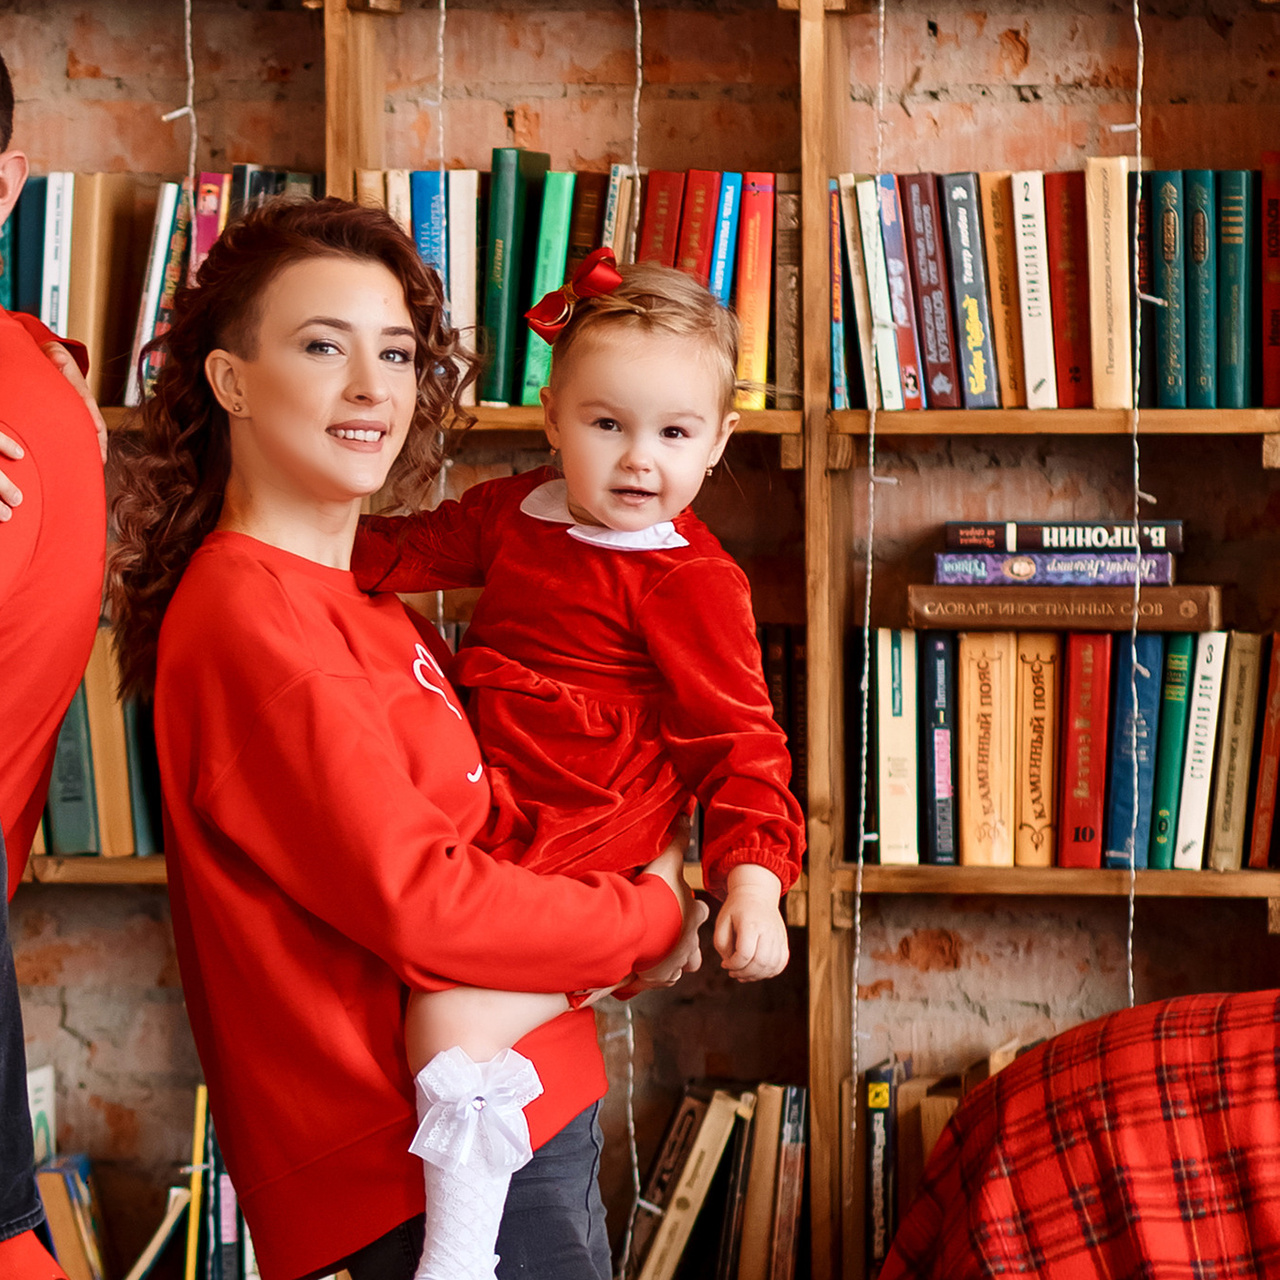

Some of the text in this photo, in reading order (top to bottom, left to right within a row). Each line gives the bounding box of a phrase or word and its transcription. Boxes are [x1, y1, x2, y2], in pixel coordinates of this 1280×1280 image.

[962, 249, 974, 285] Театр
[1021, 212, 1042, 318] СТАНИСЛАВ ЛЕМ
[1267, 198, 1280, 346] Иван КОЗЛОВ
[931, 289, 951, 363] КУЗНЕЦОВ
[1042, 526, 1166, 549] В. ПРОНИН
[924, 602, 1163, 616] СЛОВАРЬ ИНОСТРАННЫХ СЛОВ
[976, 660, 995, 816] КАМЕННЫЙ ПОЯС
[1028, 663, 1046, 820] КАМЕННЫЙ ПОЯС
[1189, 673, 1213, 781] СТАНИСЛАВ ЛЕМ
